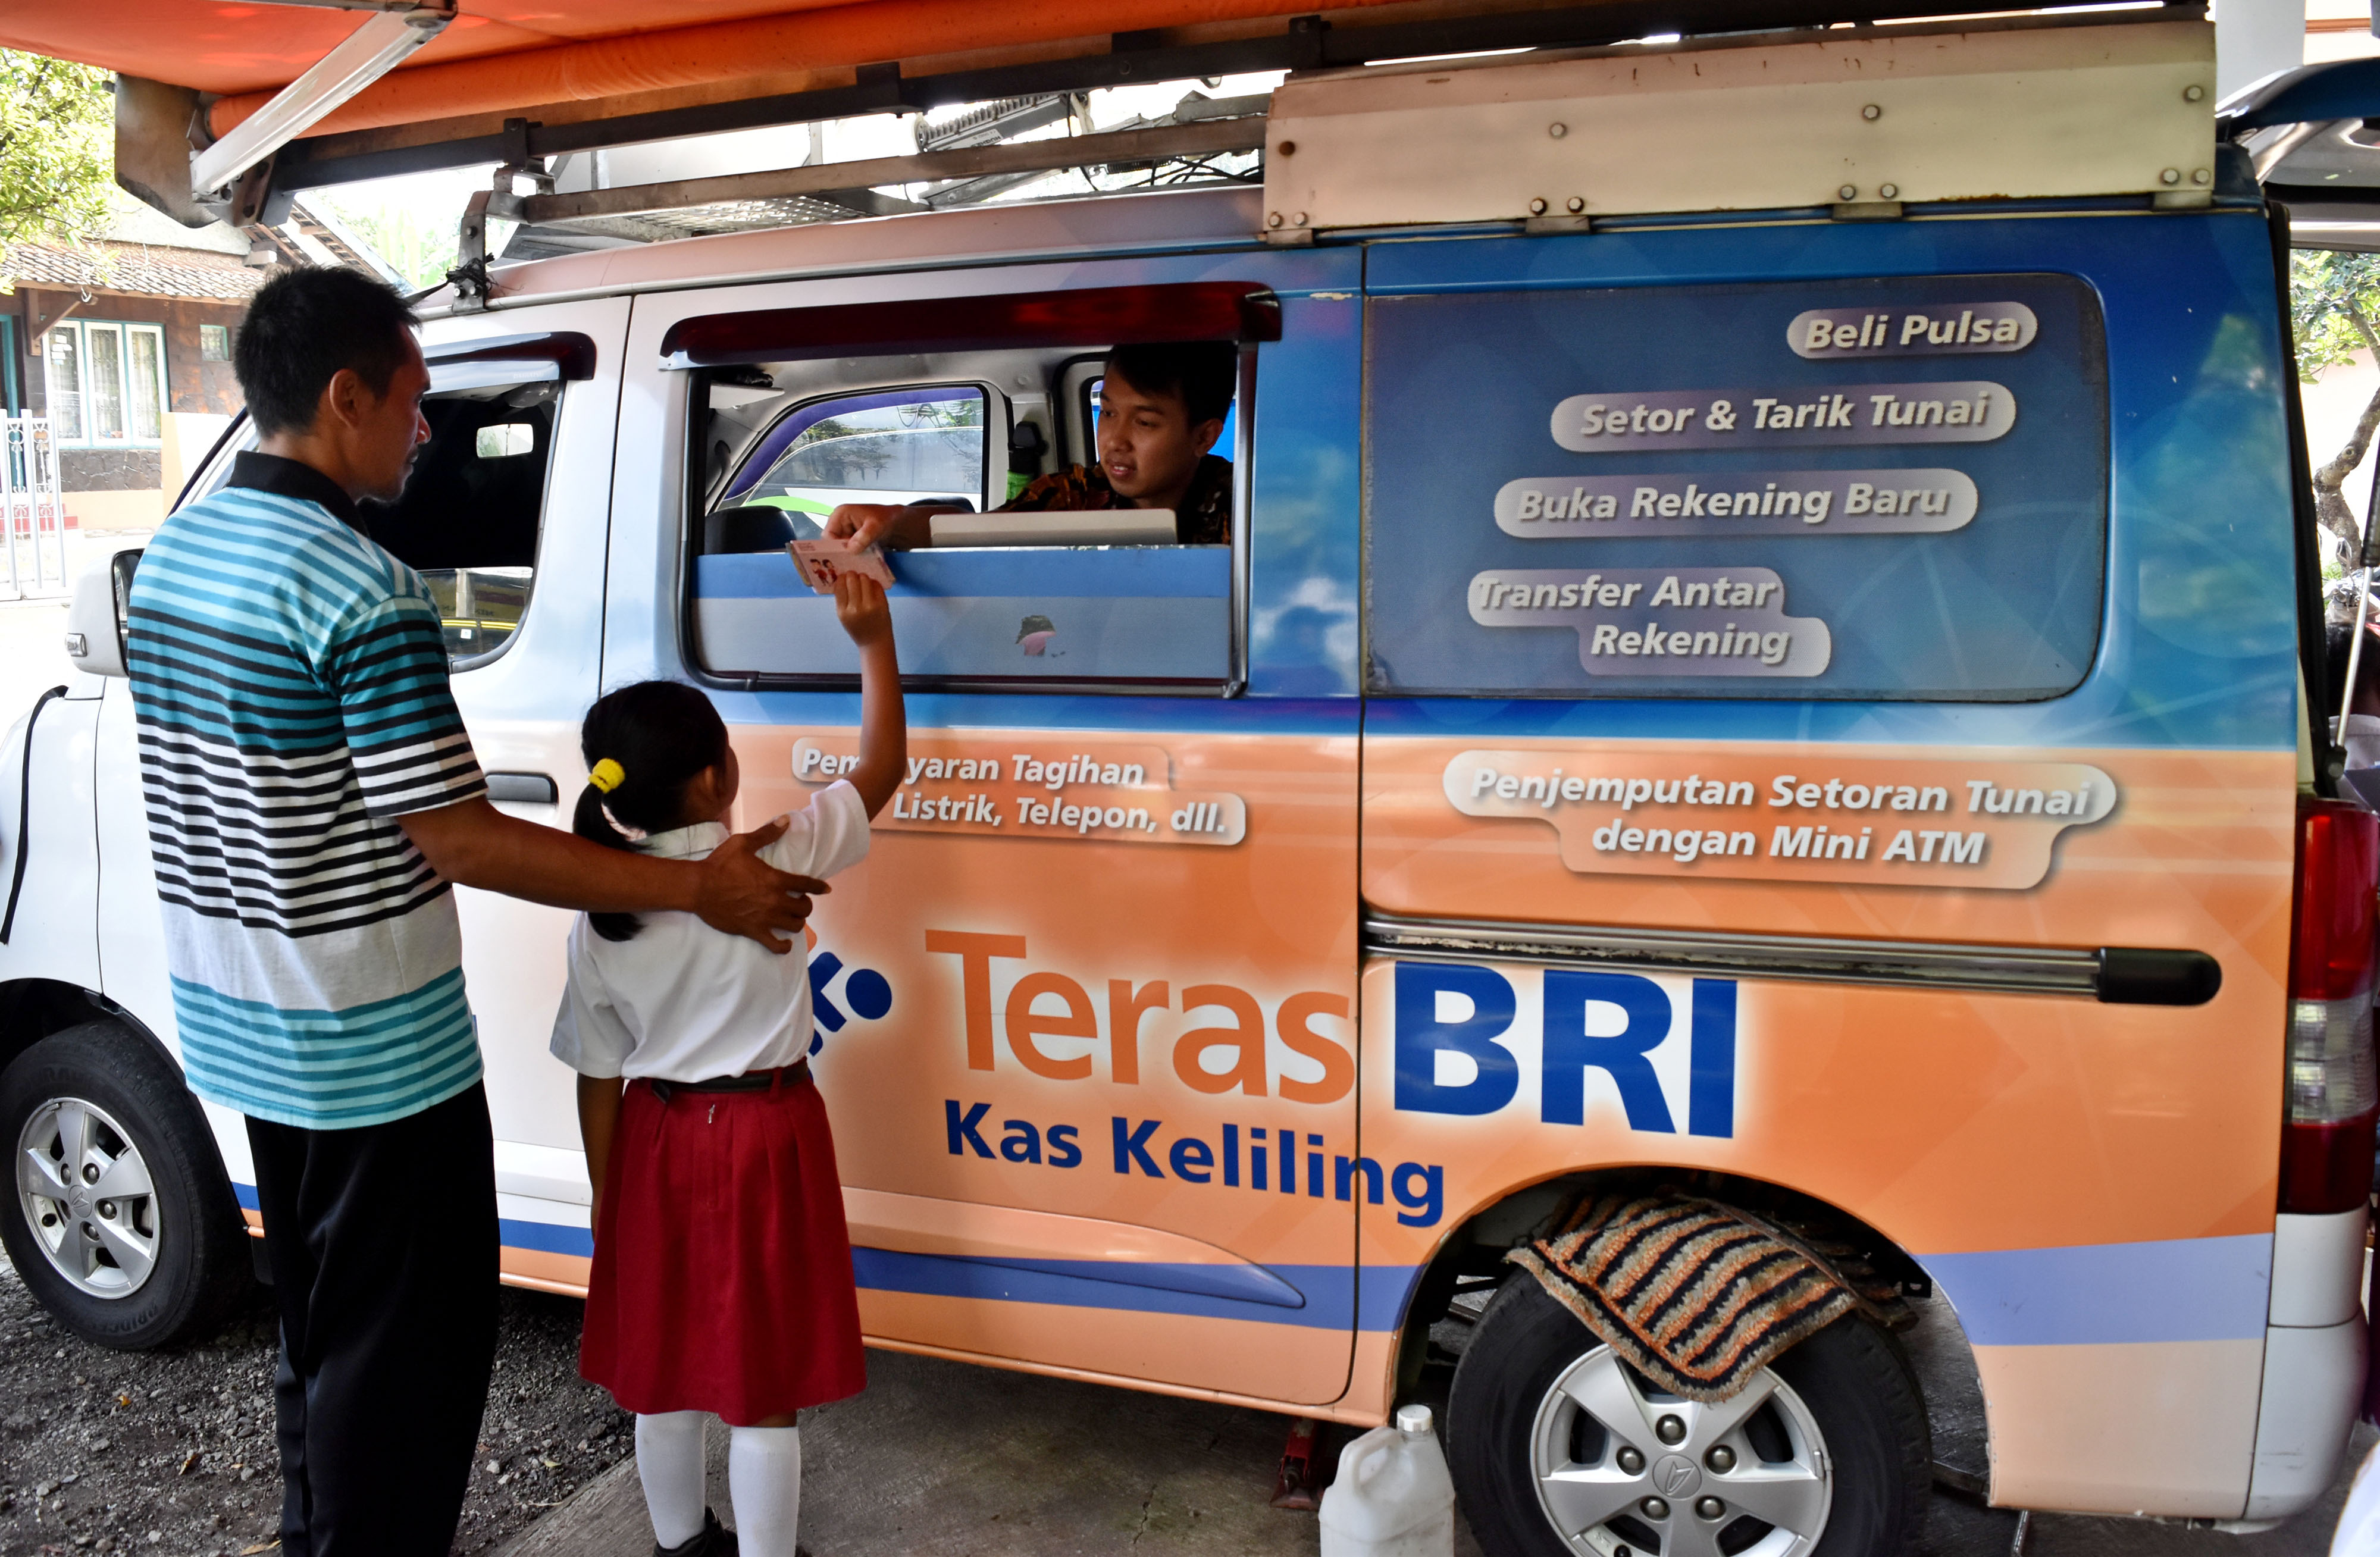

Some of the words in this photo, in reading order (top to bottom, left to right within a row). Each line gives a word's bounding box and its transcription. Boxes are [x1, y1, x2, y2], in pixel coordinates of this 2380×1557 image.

[1805, 315, 1887, 351] Beli
[1900, 311, 2019, 346] Pulsa
[1582, 403, 1694, 436] Setor
[1706, 401, 1736, 431] &
[1752, 395, 1852, 428] Tarik
[1869, 391, 1990, 425] Tunai
[1518, 489, 1617, 521] Buka
[1630, 484, 1832, 524] Rekening
[1845, 484, 1949, 515] Baru
[1478, 576, 1642, 609] Transfer
[1650, 577, 1777, 607] Antar
[1590, 624, 1789, 664] Rekening
[801, 748, 1000, 785] Pemyaran
[1012, 754, 1145, 790] Tagihan
[893, 792, 1003, 826] Listrik,
[1016, 797, 1158, 834] Telepon,
[1170, 801, 1225, 833] dll.
[1471, 768, 1755, 810] Penjemputan
[1768, 776, 1947, 812] Setoran
[1966, 781, 2090, 816] Tunai
[1593, 819, 1756, 863] dengan
[1770, 826, 1871, 860] Mini
[1884, 831, 1984, 864] ATM
[926, 929, 1357, 1105] Teras
[1394, 960, 1737, 1139] BRI
[944, 1099, 1082, 1169] Kas
[1111, 1116, 1443, 1227] Keliling
